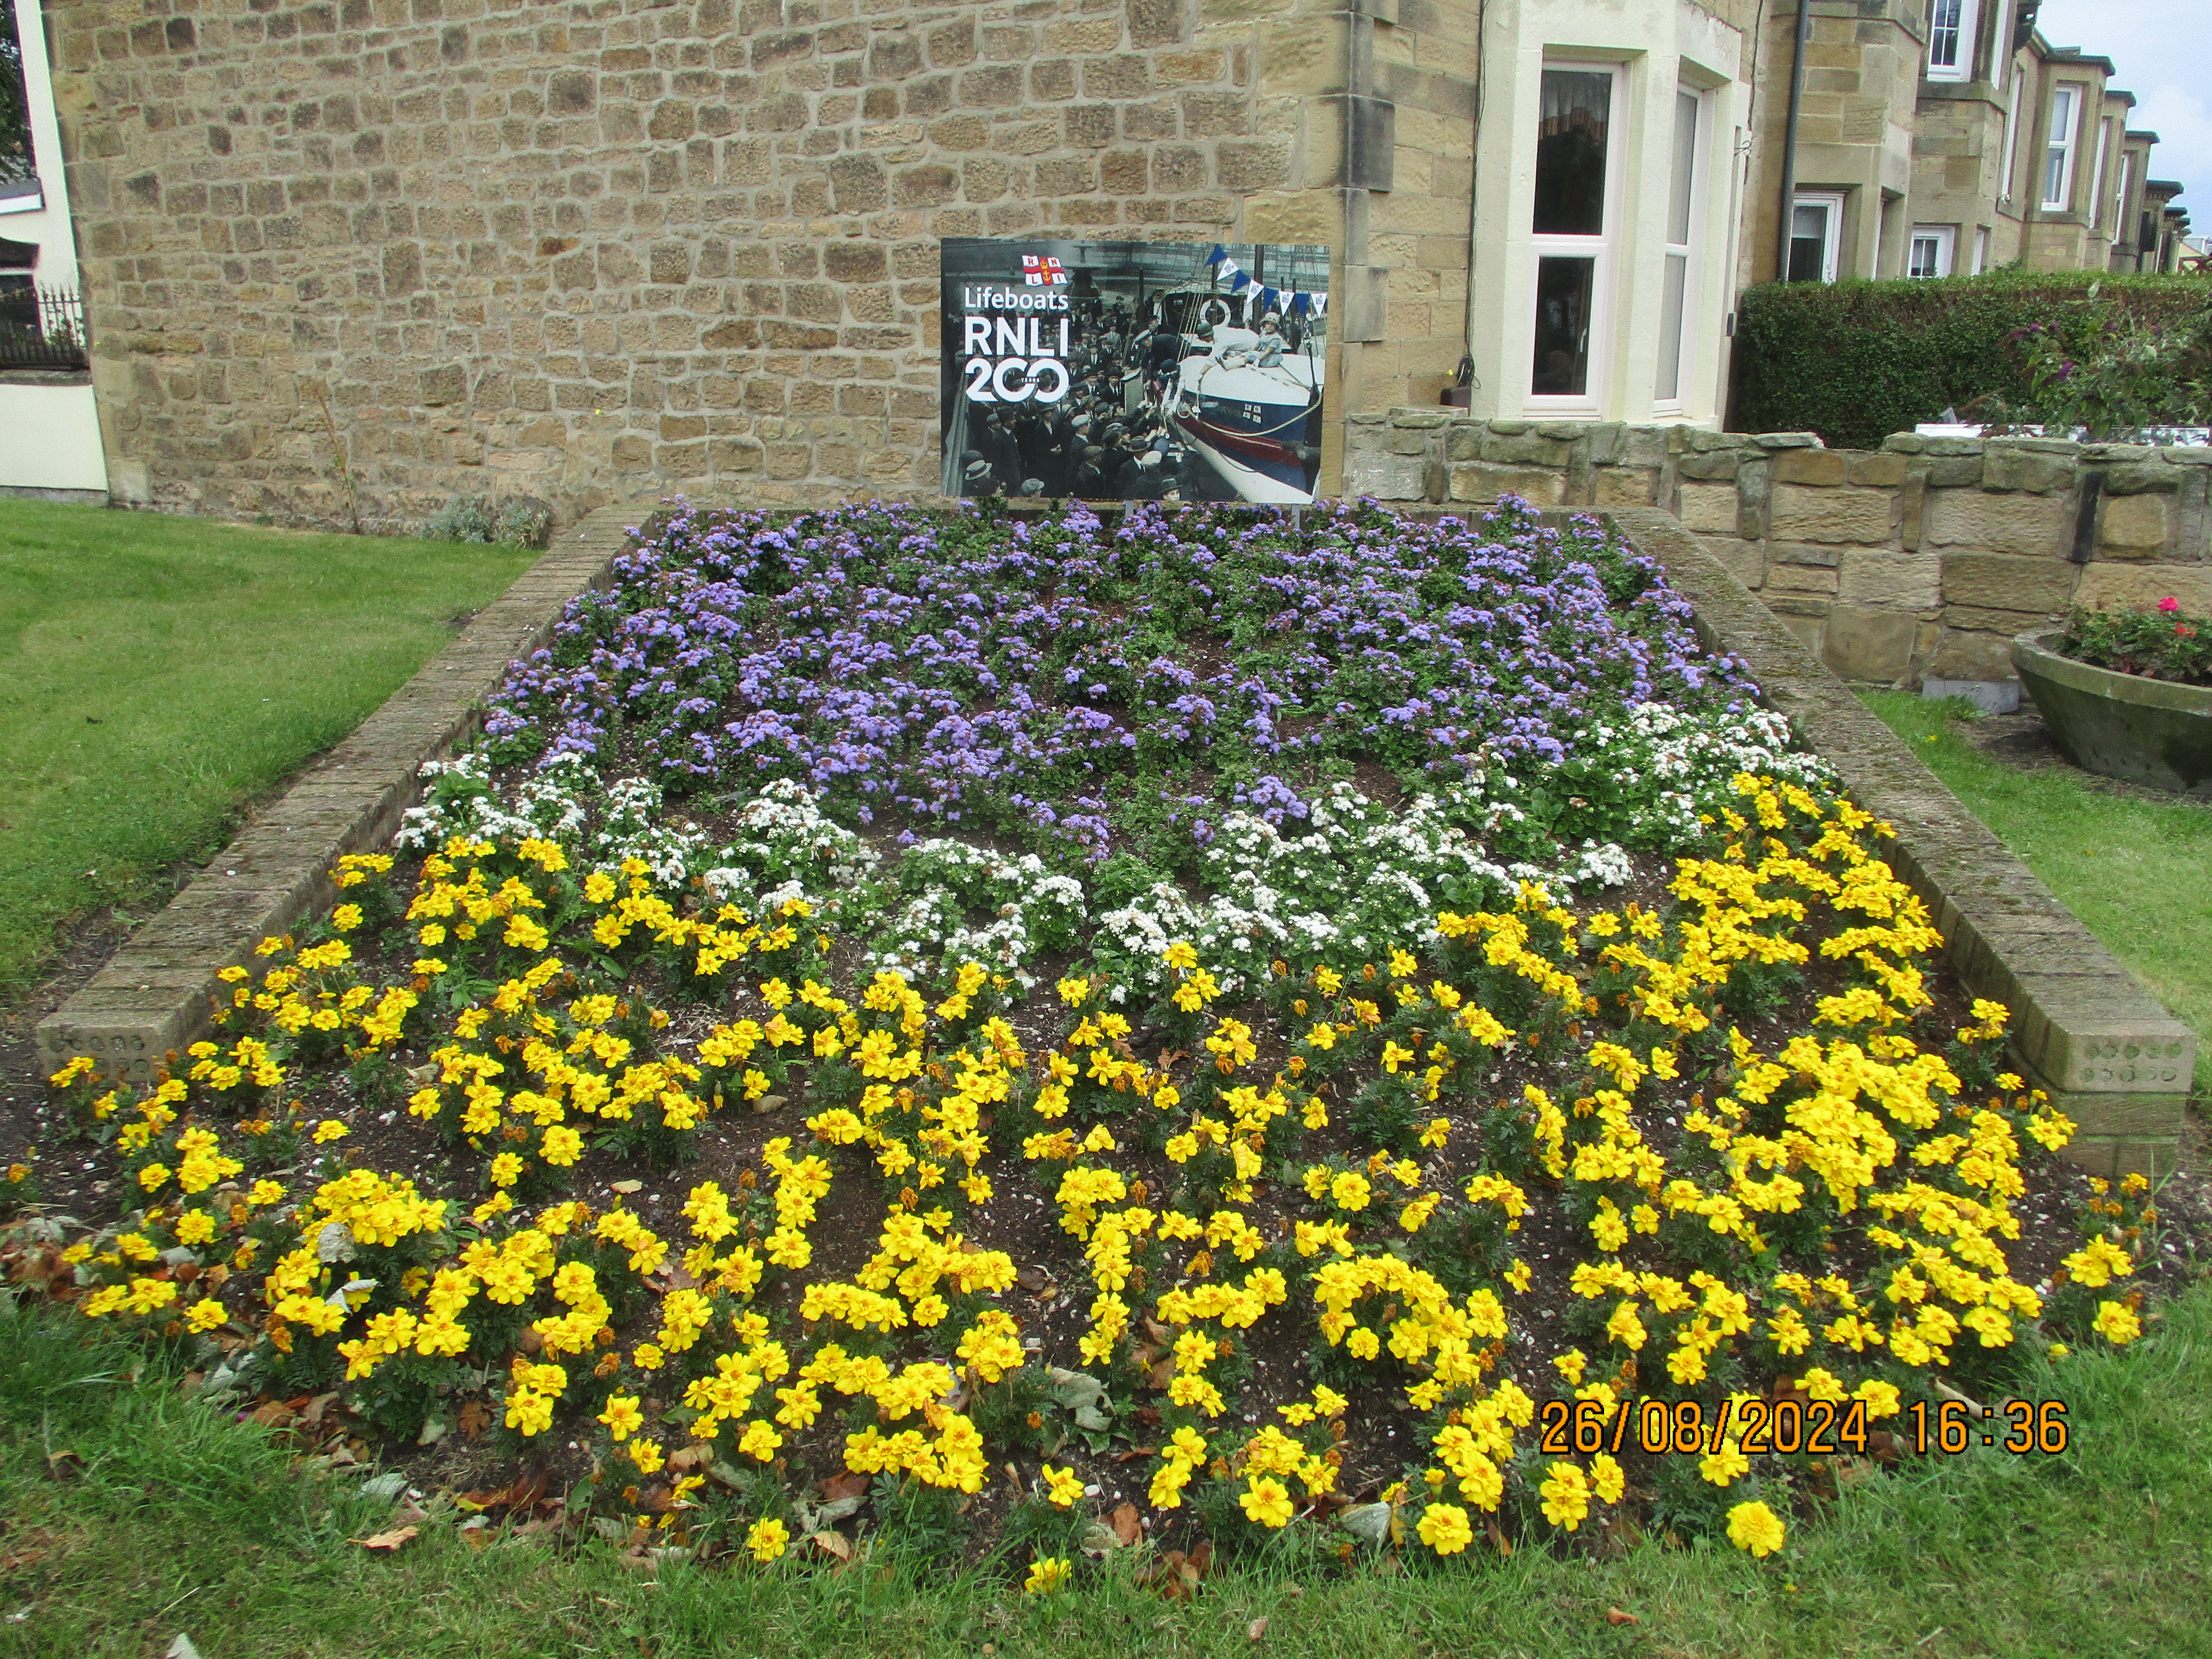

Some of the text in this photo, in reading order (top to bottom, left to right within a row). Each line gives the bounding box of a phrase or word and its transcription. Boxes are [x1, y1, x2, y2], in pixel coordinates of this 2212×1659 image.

[965, 286, 1069, 310] Lifeboats
[965, 316, 1069, 357] RNLI
[965, 357, 1070, 403] 200
